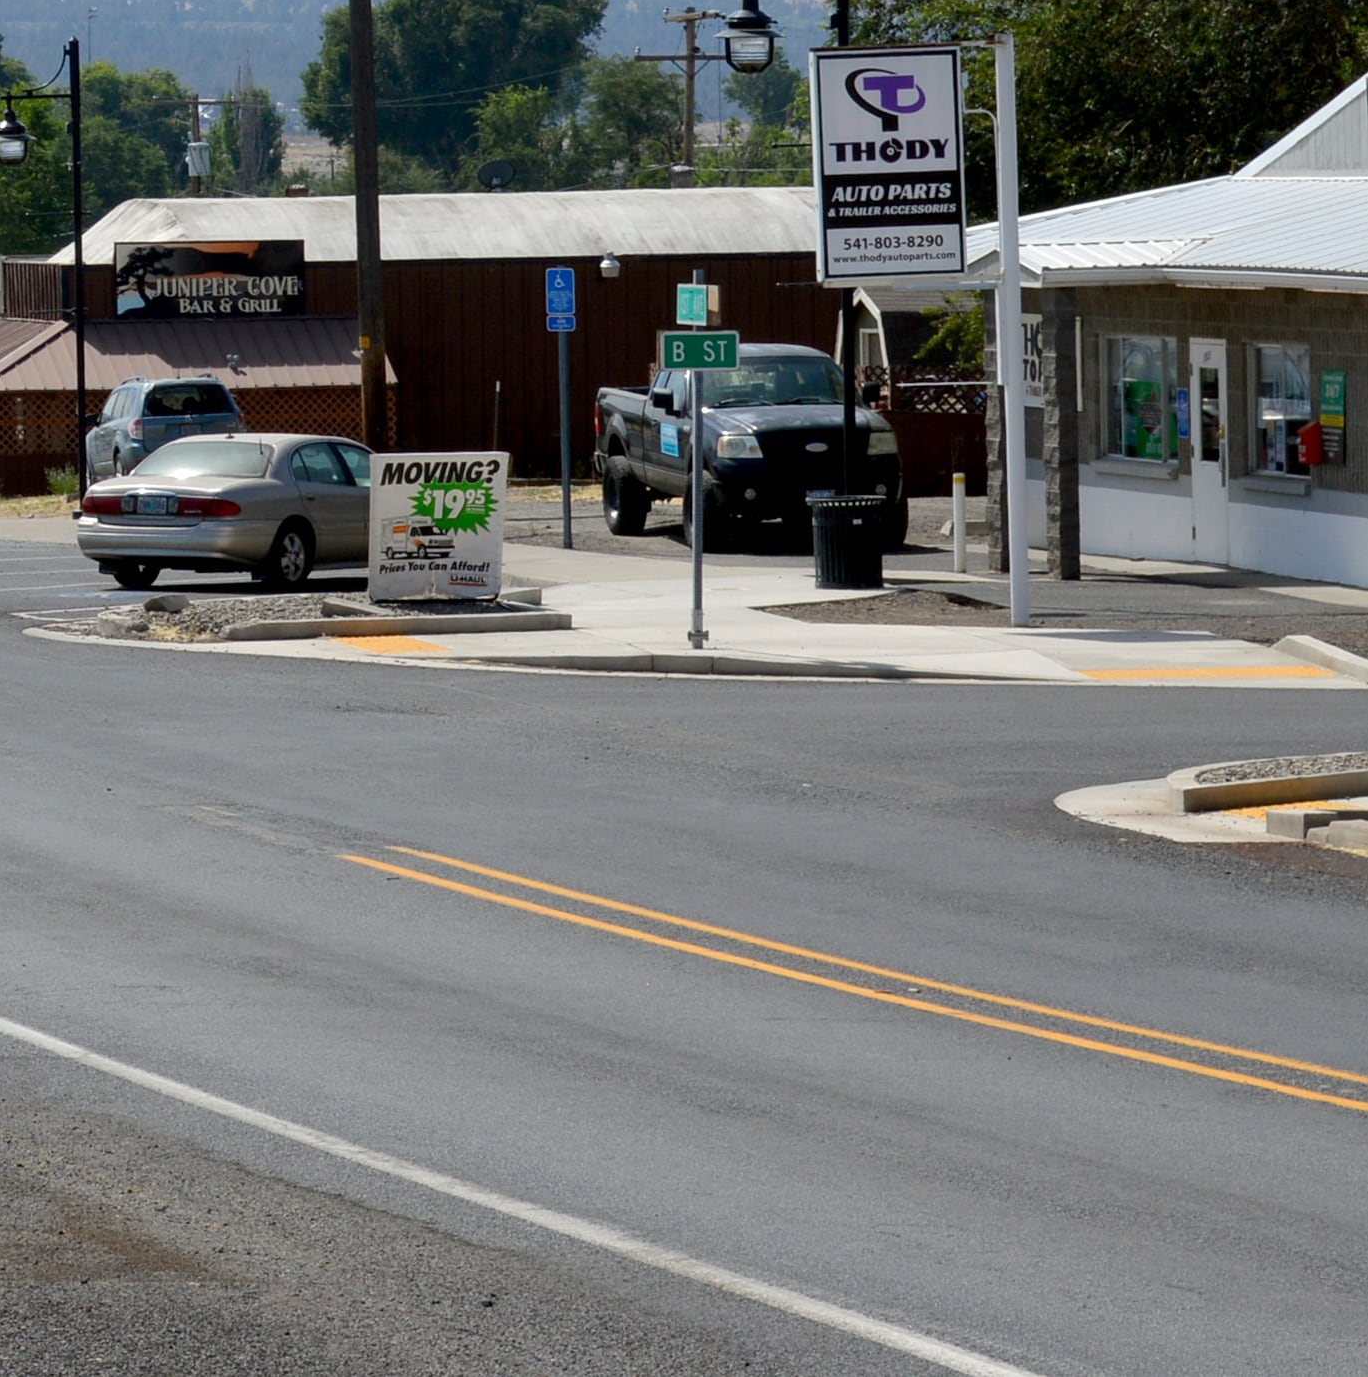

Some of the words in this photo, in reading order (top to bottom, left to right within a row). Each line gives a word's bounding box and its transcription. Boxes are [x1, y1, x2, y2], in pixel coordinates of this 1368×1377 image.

[829, 137, 949, 164] THODY
[831, 184, 885, 203] AUTO
[887, 182, 952, 201] PARTS
[828, 208, 836, 218] &
[838, 206, 882, 217] TRAILER
[883, 203, 956, 216] ACCESSORIES
[843, 234, 944, 251] 541-803-8290
[833, 251, 956, 264] www.thodyautoparts.com
[153, 276, 237, 298] JUNIPER
[247, 275, 299, 297] COVE
[219, 298, 233, 313] &
[672, 341, 685, 363] B
[703, 341, 728, 362] ST
[380, 459, 501, 486] MOVING?
[379, 563, 406, 574] Prices
[408, 561, 426, 572] You
[428, 561, 448, 571] Can
[450, 561, 491, 573] Afford!
